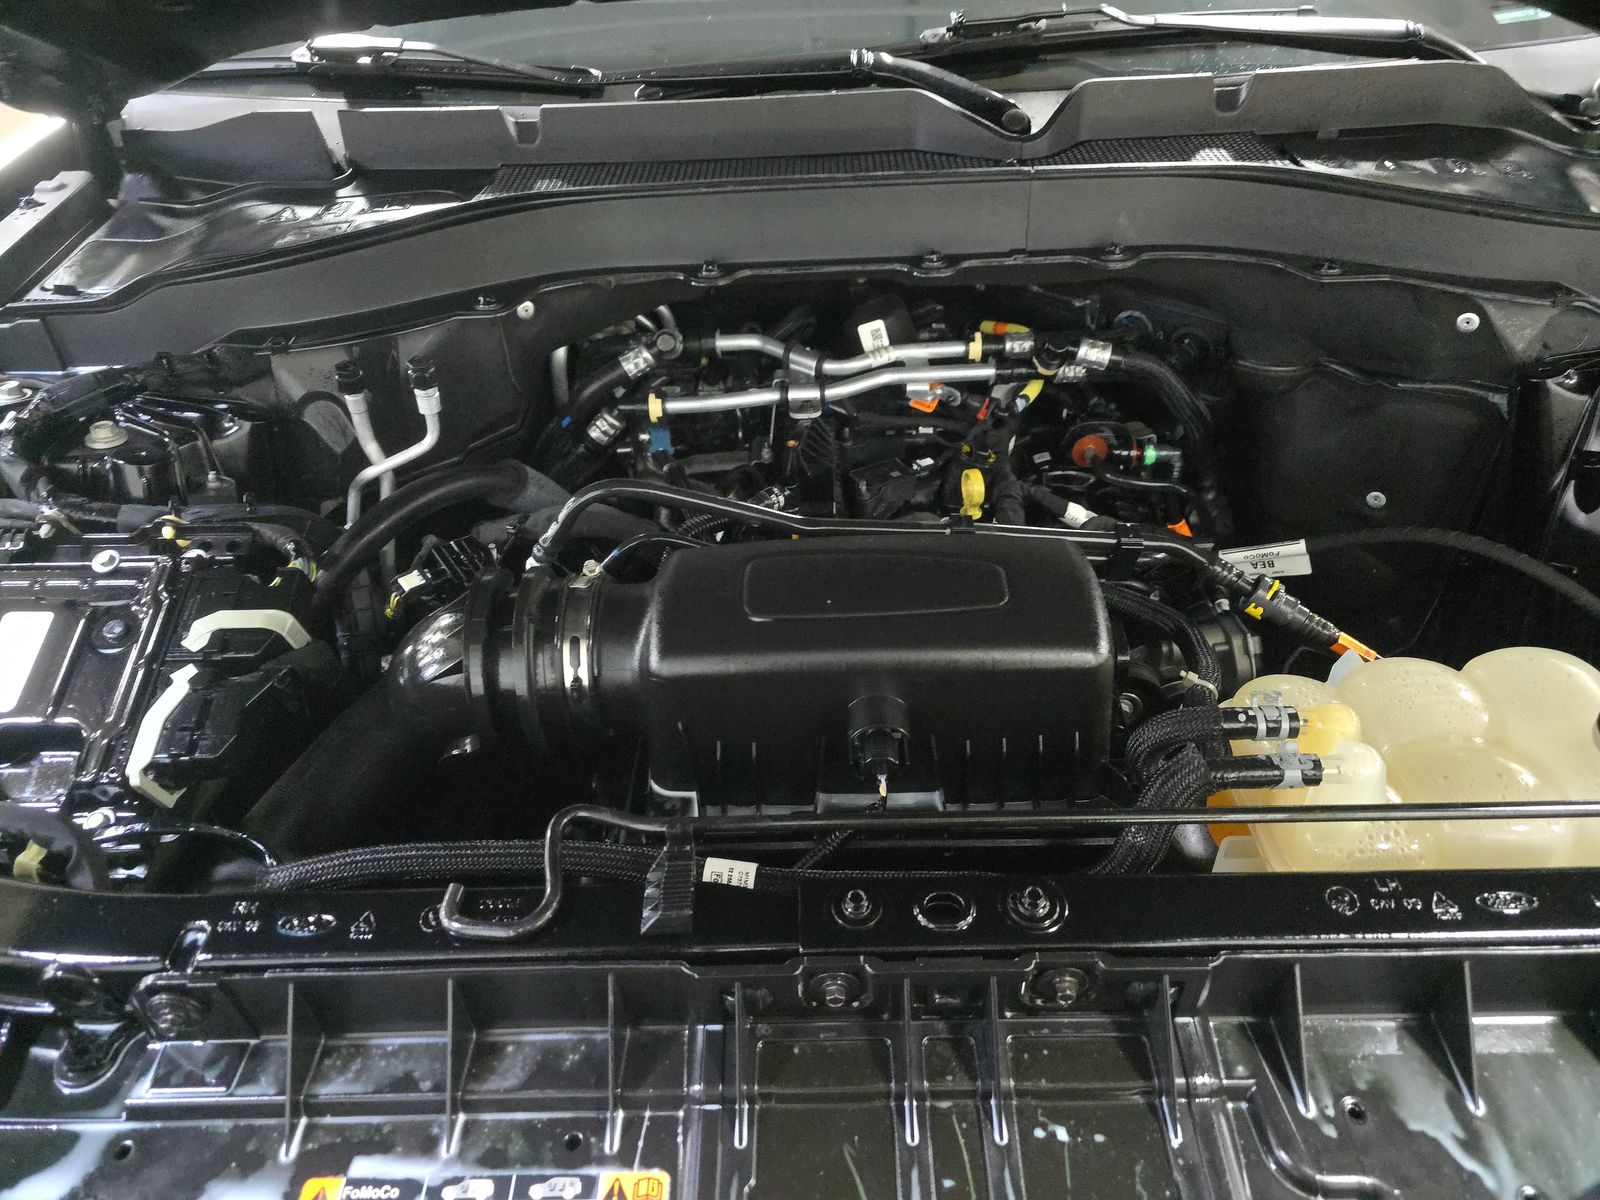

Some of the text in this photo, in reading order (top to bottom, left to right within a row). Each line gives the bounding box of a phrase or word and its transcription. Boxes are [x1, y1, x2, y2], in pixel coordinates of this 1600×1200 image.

[1243, 551, 1280, 560] FoMoCo
[1250, 560, 1275, 569] BEA
[341, 1185, 400, 1200] FoMoCo
